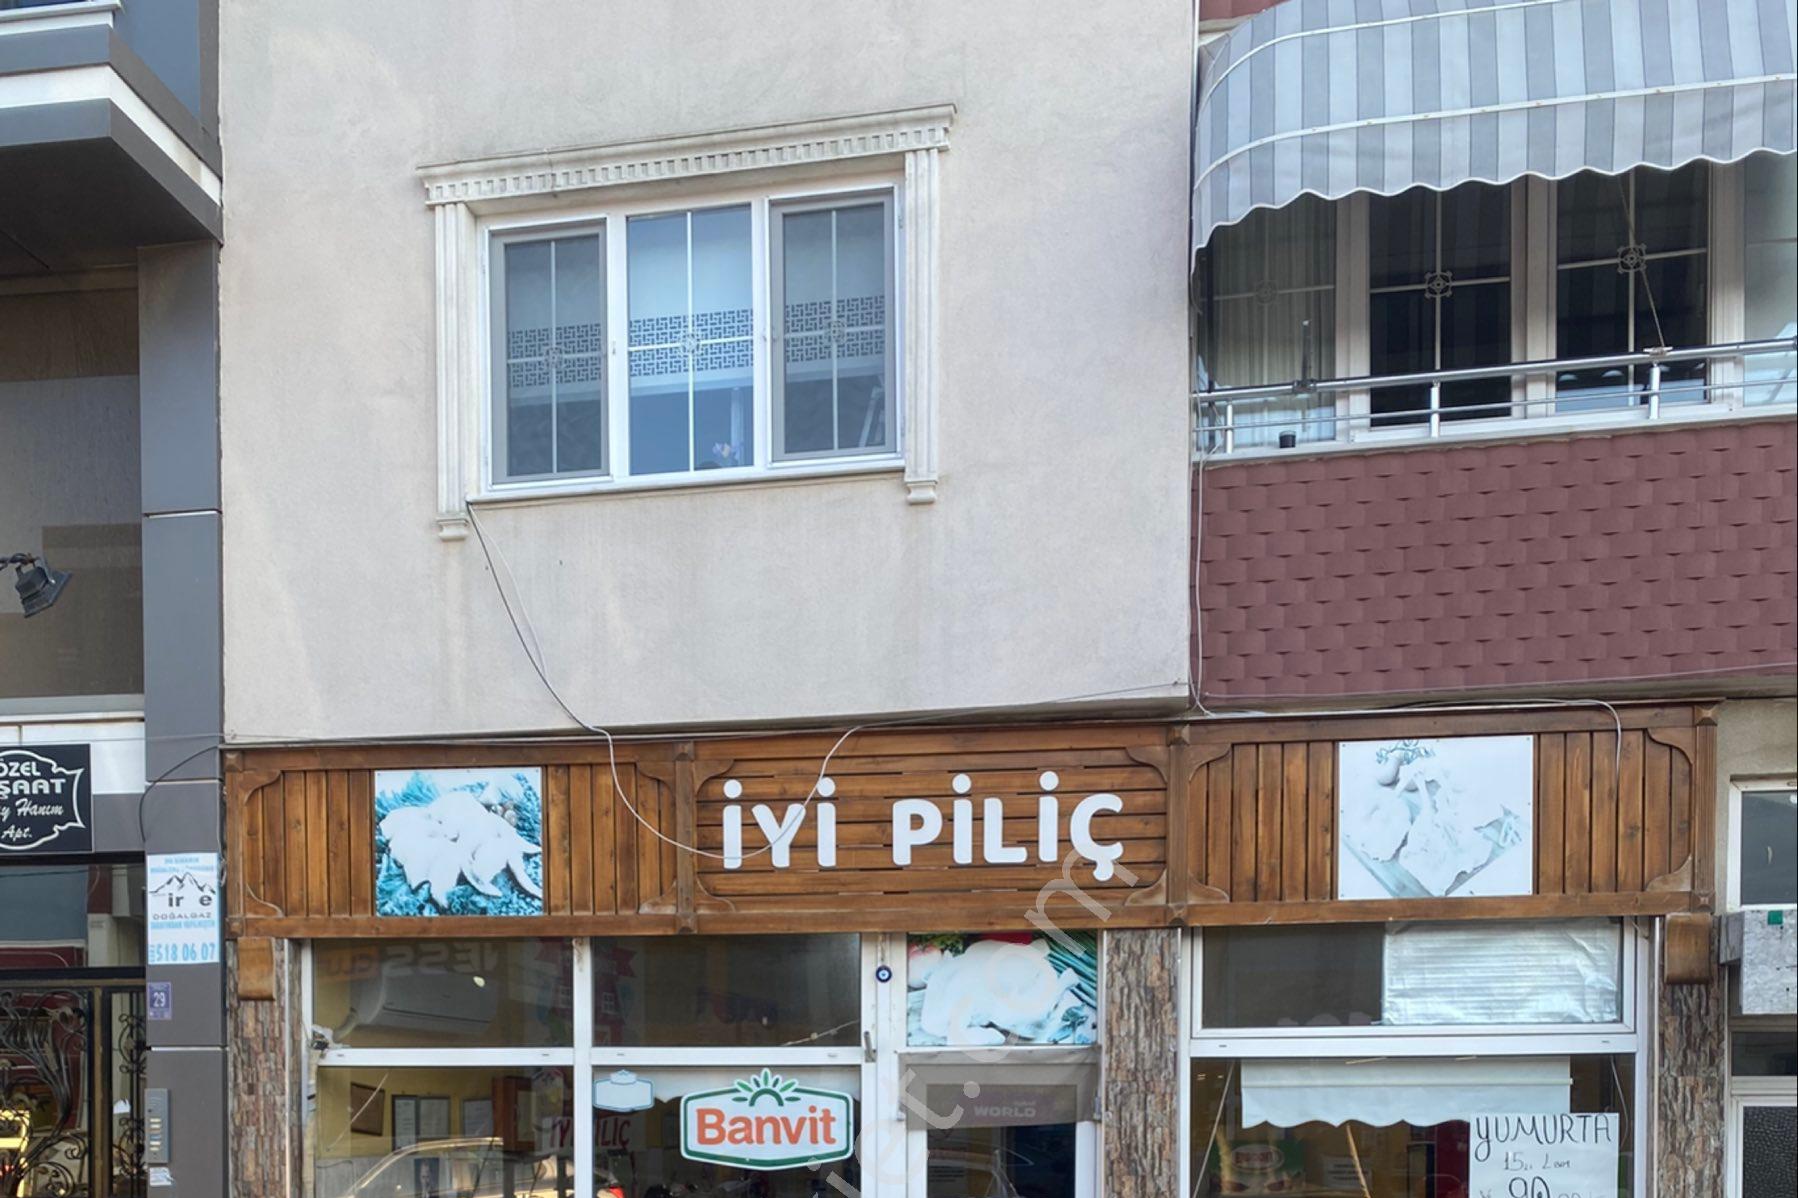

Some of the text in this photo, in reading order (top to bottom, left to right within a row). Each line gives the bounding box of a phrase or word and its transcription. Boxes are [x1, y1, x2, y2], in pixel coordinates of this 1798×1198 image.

[722, 770, 1124, 882] İYİ PİLİÇ
[182, 943, 197, 961] 06
[201, 942, 216, 961] 07
[153, 991, 167, 1008] 29
[696, 1105, 837, 1146] Banvit
[973, 1105, 1037, 1118] WORLD
[1474, 1113, 1612, 1162] YUMURTA
